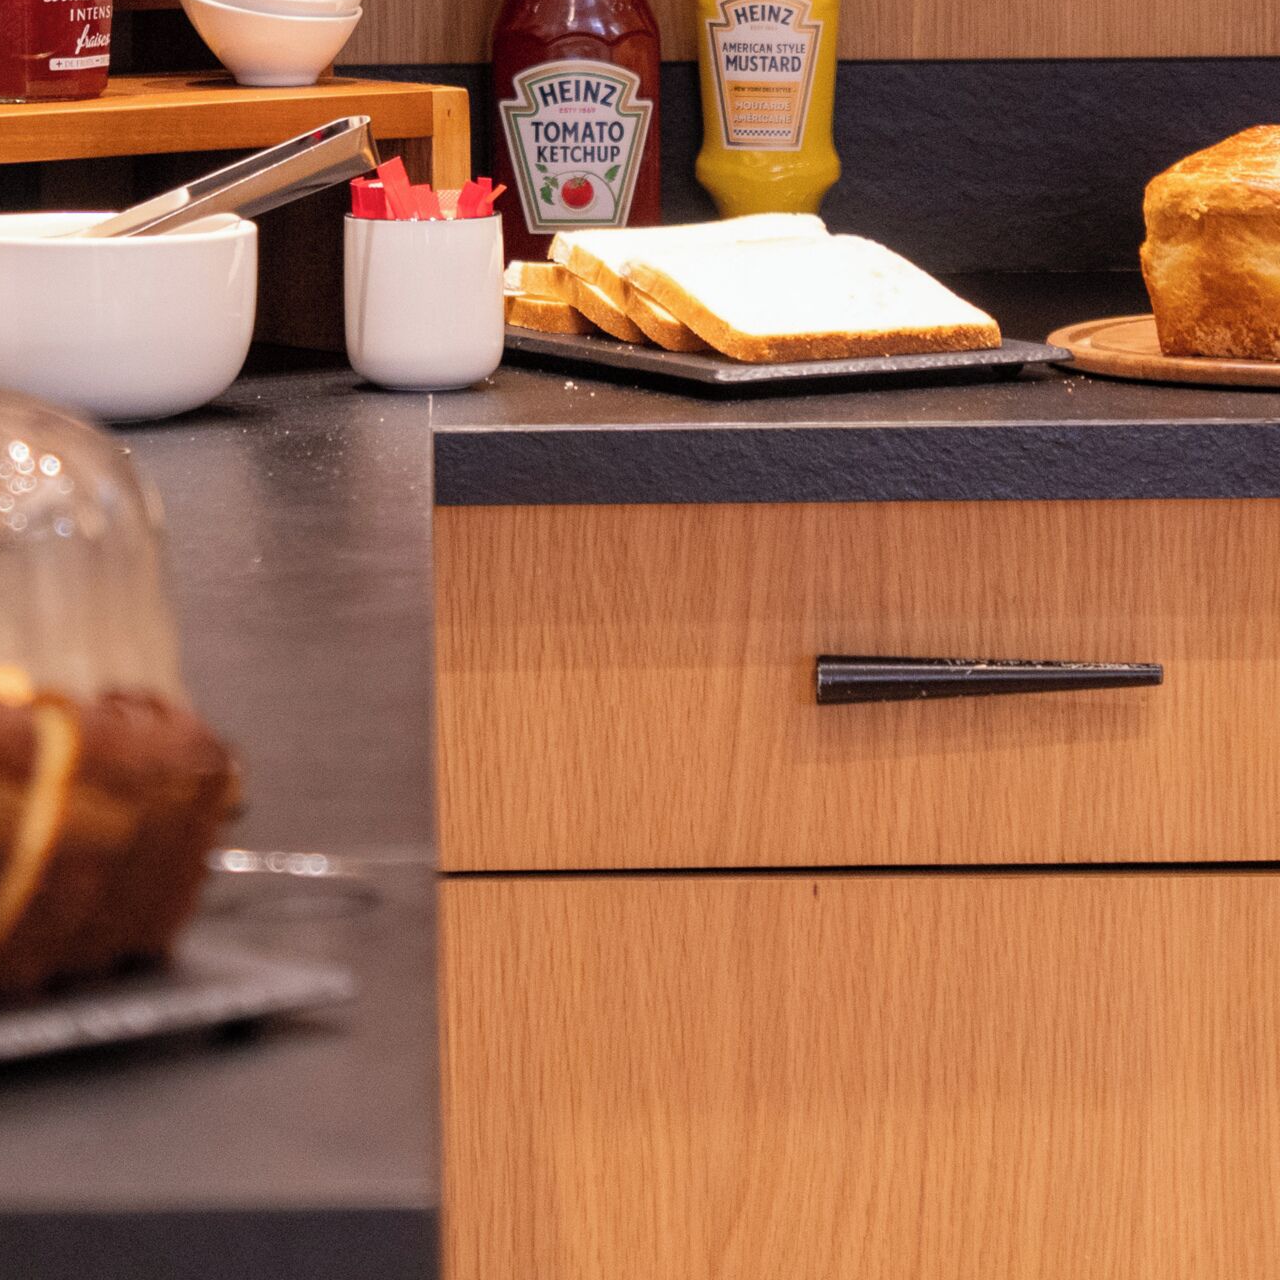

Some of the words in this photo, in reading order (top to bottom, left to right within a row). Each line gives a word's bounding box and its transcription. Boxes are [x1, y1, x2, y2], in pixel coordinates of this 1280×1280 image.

[70, 5, 111, 22] INTENS
[734, 4, 794, 25] HEINZ
[722, 42, 773, 54] AMERICAN
[776, 43, 806, 54] STYLE
[725, 55, 802, 73] MUSTARD
[538, 80, 618, 108] HEINZ
[531, 121, 624, 143] TOMATO
[537, 146, 620, 163] KETCHUP
